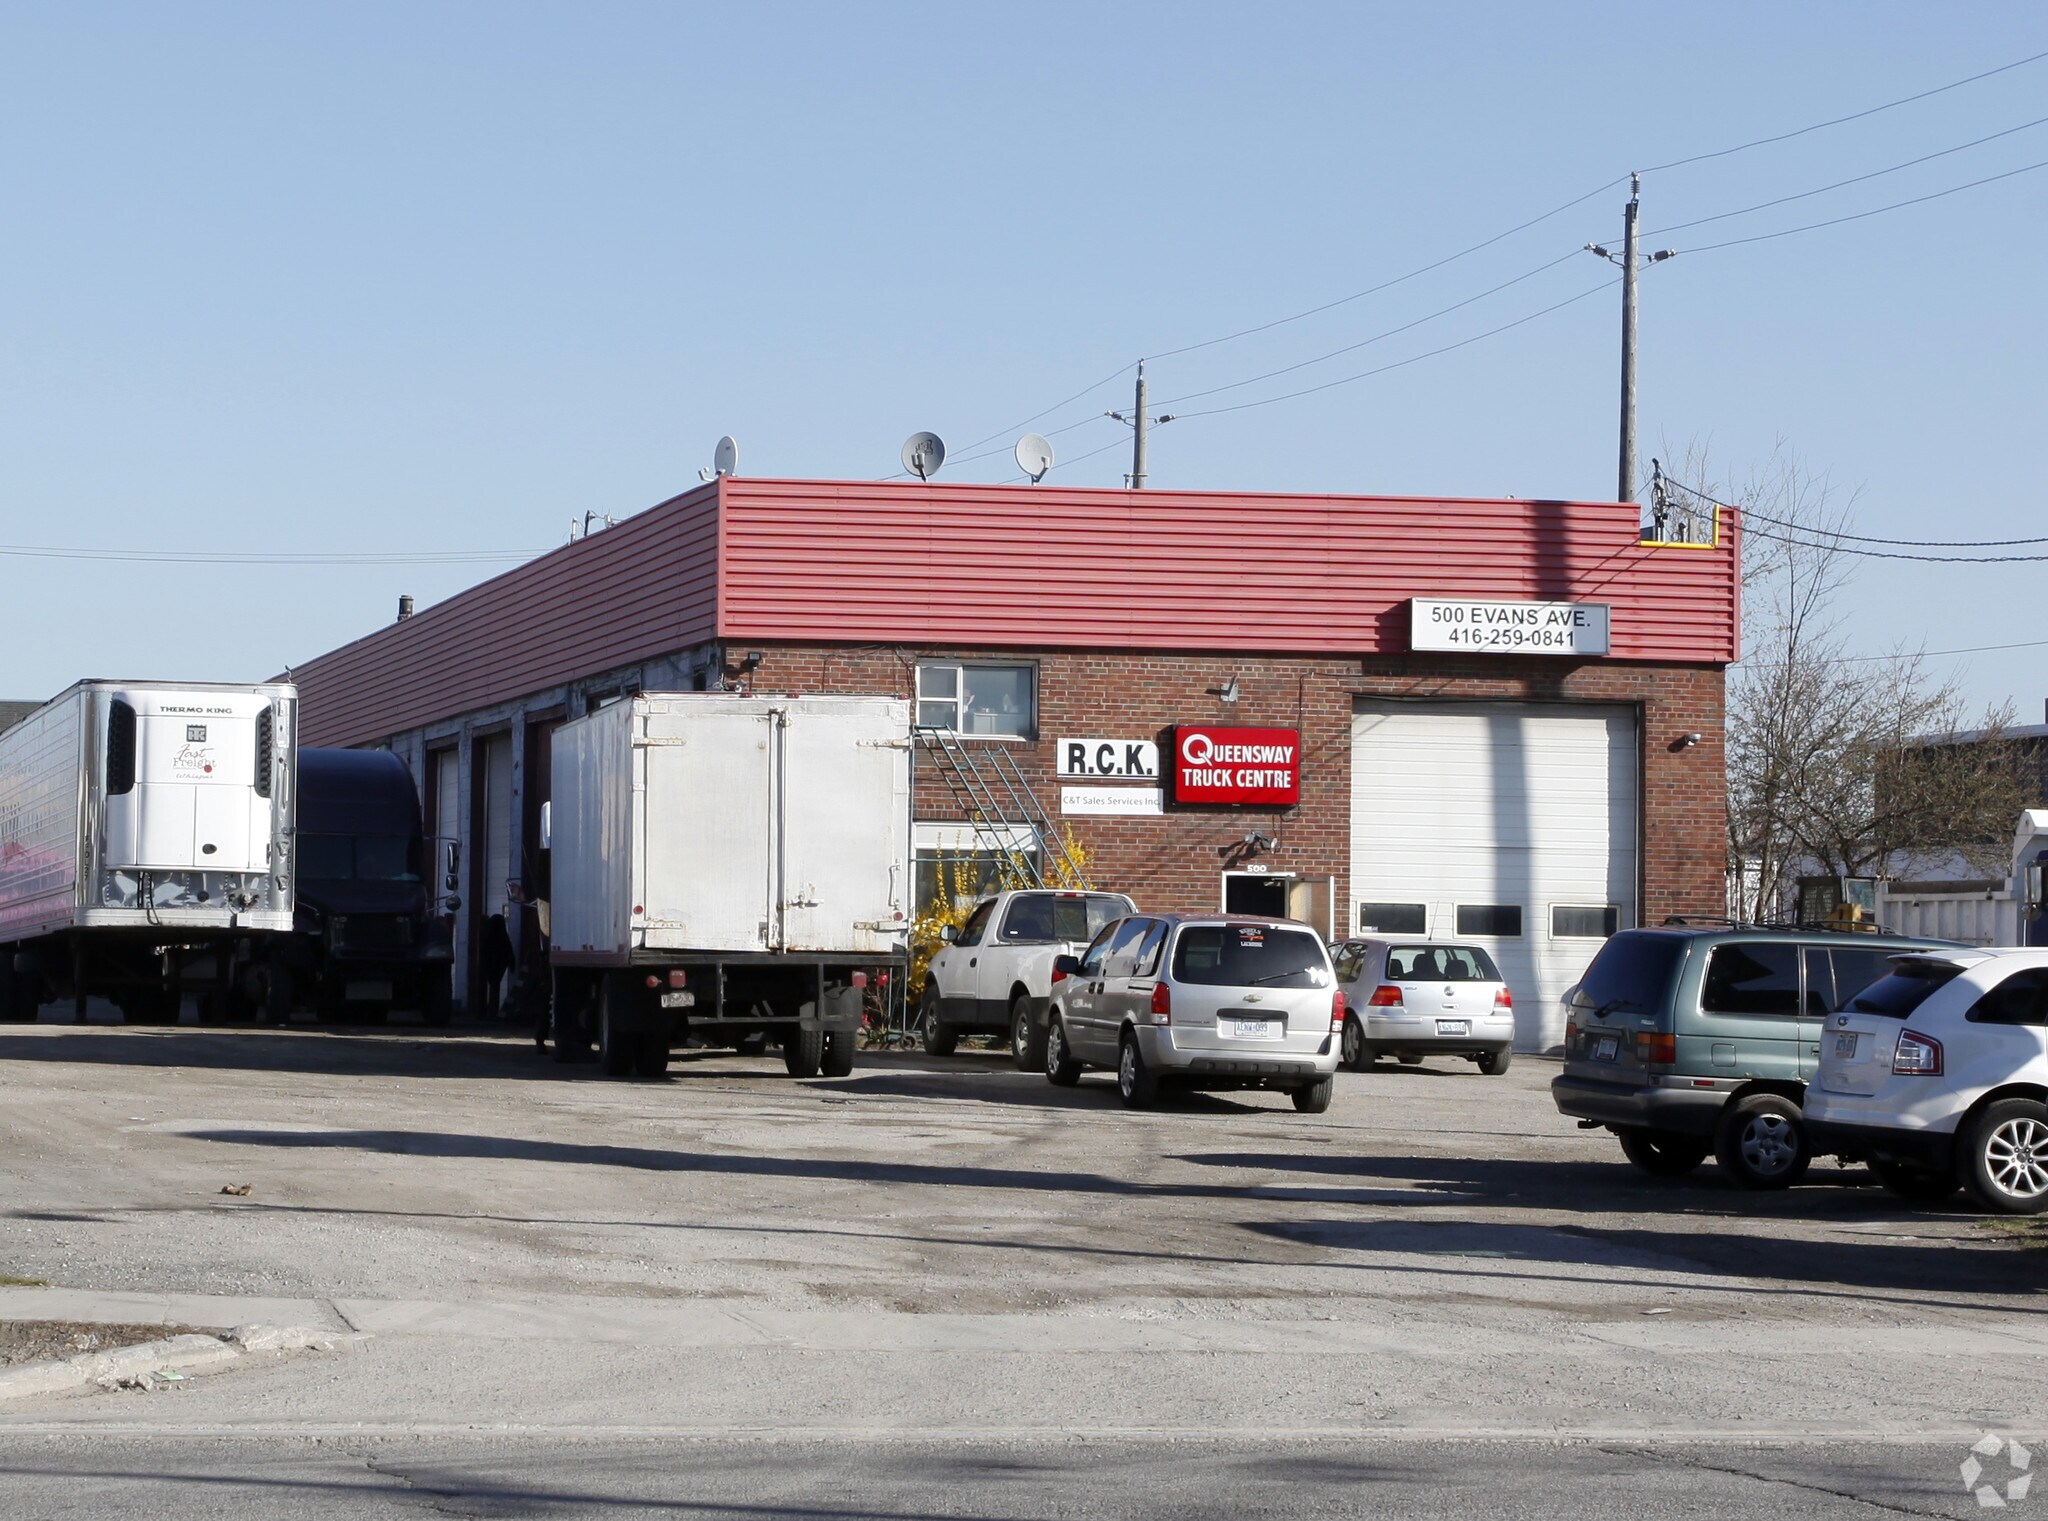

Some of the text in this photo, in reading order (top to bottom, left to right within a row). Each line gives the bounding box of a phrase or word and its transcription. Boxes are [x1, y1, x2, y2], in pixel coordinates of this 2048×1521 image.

[1431, 606, 1591, 627] 500 EVANS AVE.
[1449, 628, 1574, 647] 416-259-0841
[177, 743, 215, 761] Fast
[1068, 742, 1153, 775] R.C.K.
[1182, 733, 1294, 767] QUEENSWAY
[1182, 768, 1292, 788] TRUCK CENTRE
[1063, 796, 1081, 805] C&T
[1083, 796, 1105, 805] Sales
[1107, 796, 1143, 806] Services
[1247, 864, 1267, 873] 500
